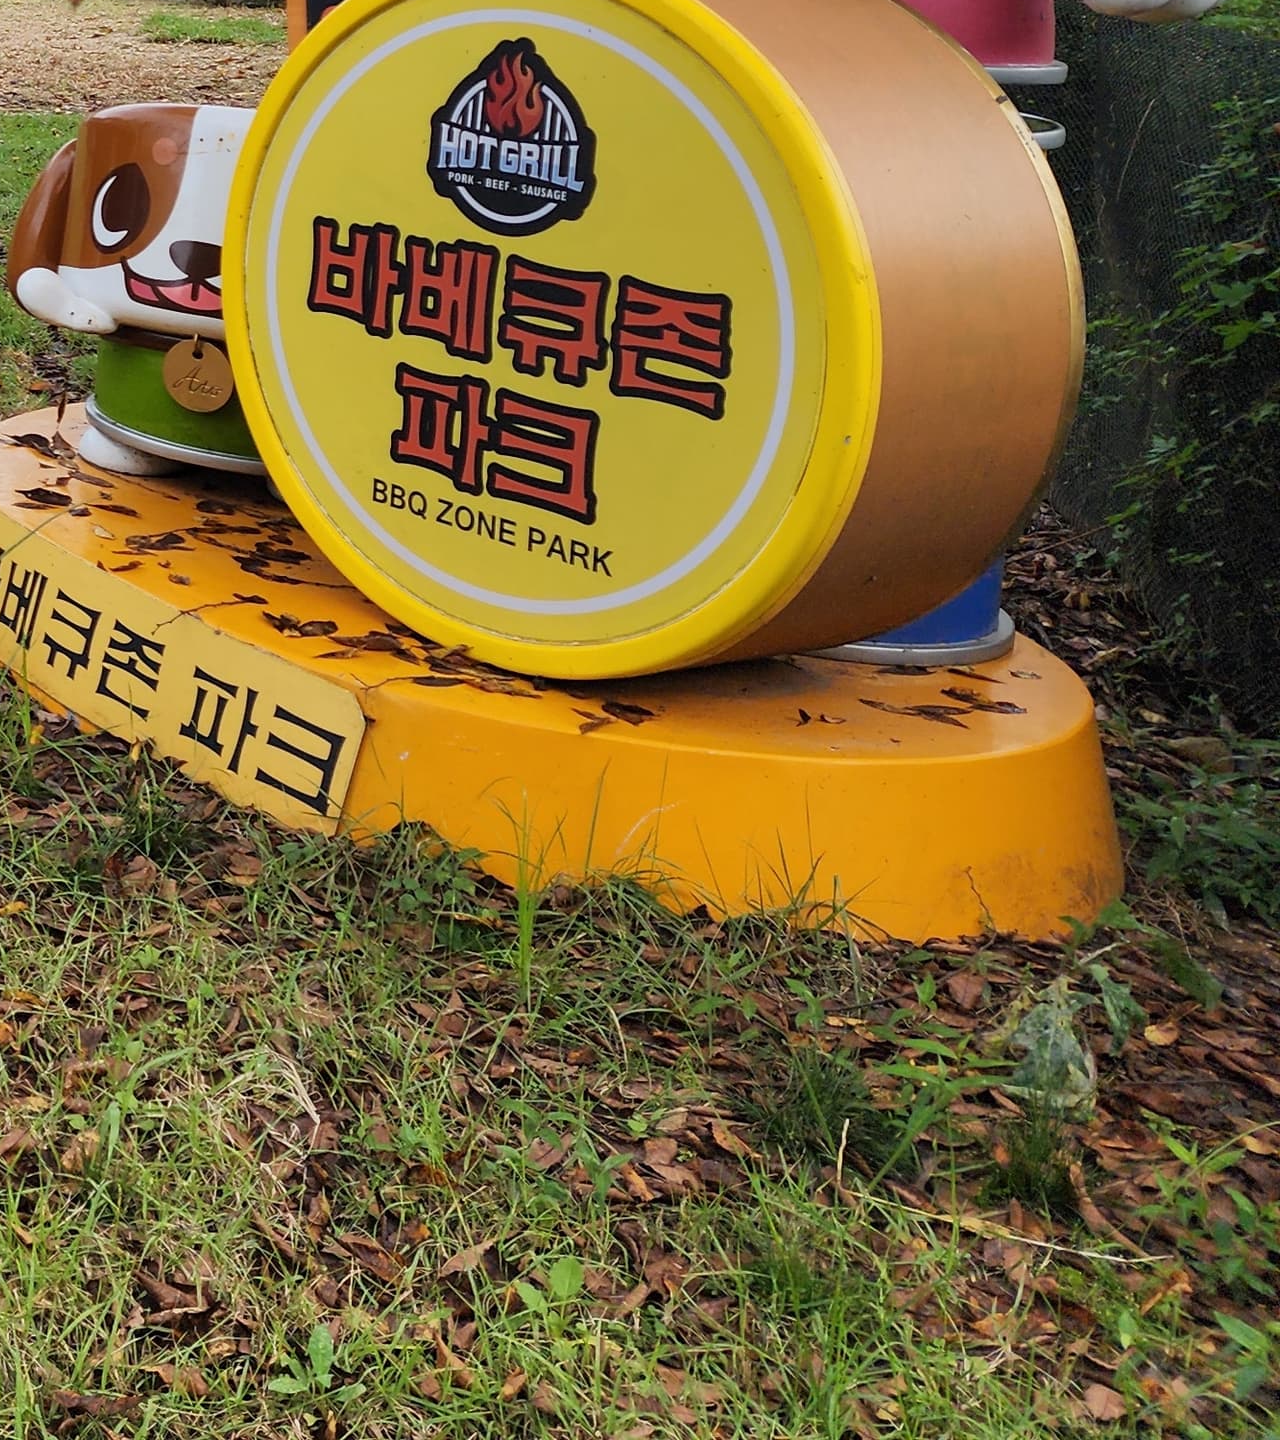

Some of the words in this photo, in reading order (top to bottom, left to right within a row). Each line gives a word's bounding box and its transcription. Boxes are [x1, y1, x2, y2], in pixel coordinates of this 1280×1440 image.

[437, 123, 498, 170] HOT
[499, 139, 584, 192] GRILL
[448, 171, 474, 185] PORK
[485, 178, 510, 191] BEEF
[521, 184, 567, 201] SAUSAGE
[308, 216, 732, 420] 바베큐존
[390, 362, 600, 525] 파크
[372, 478, 428, 520] BBQ
[435, 498, 517, 546] ZONE
[527, 527, 614, 577] PARK
[179, 665, 346, 816] 파크
